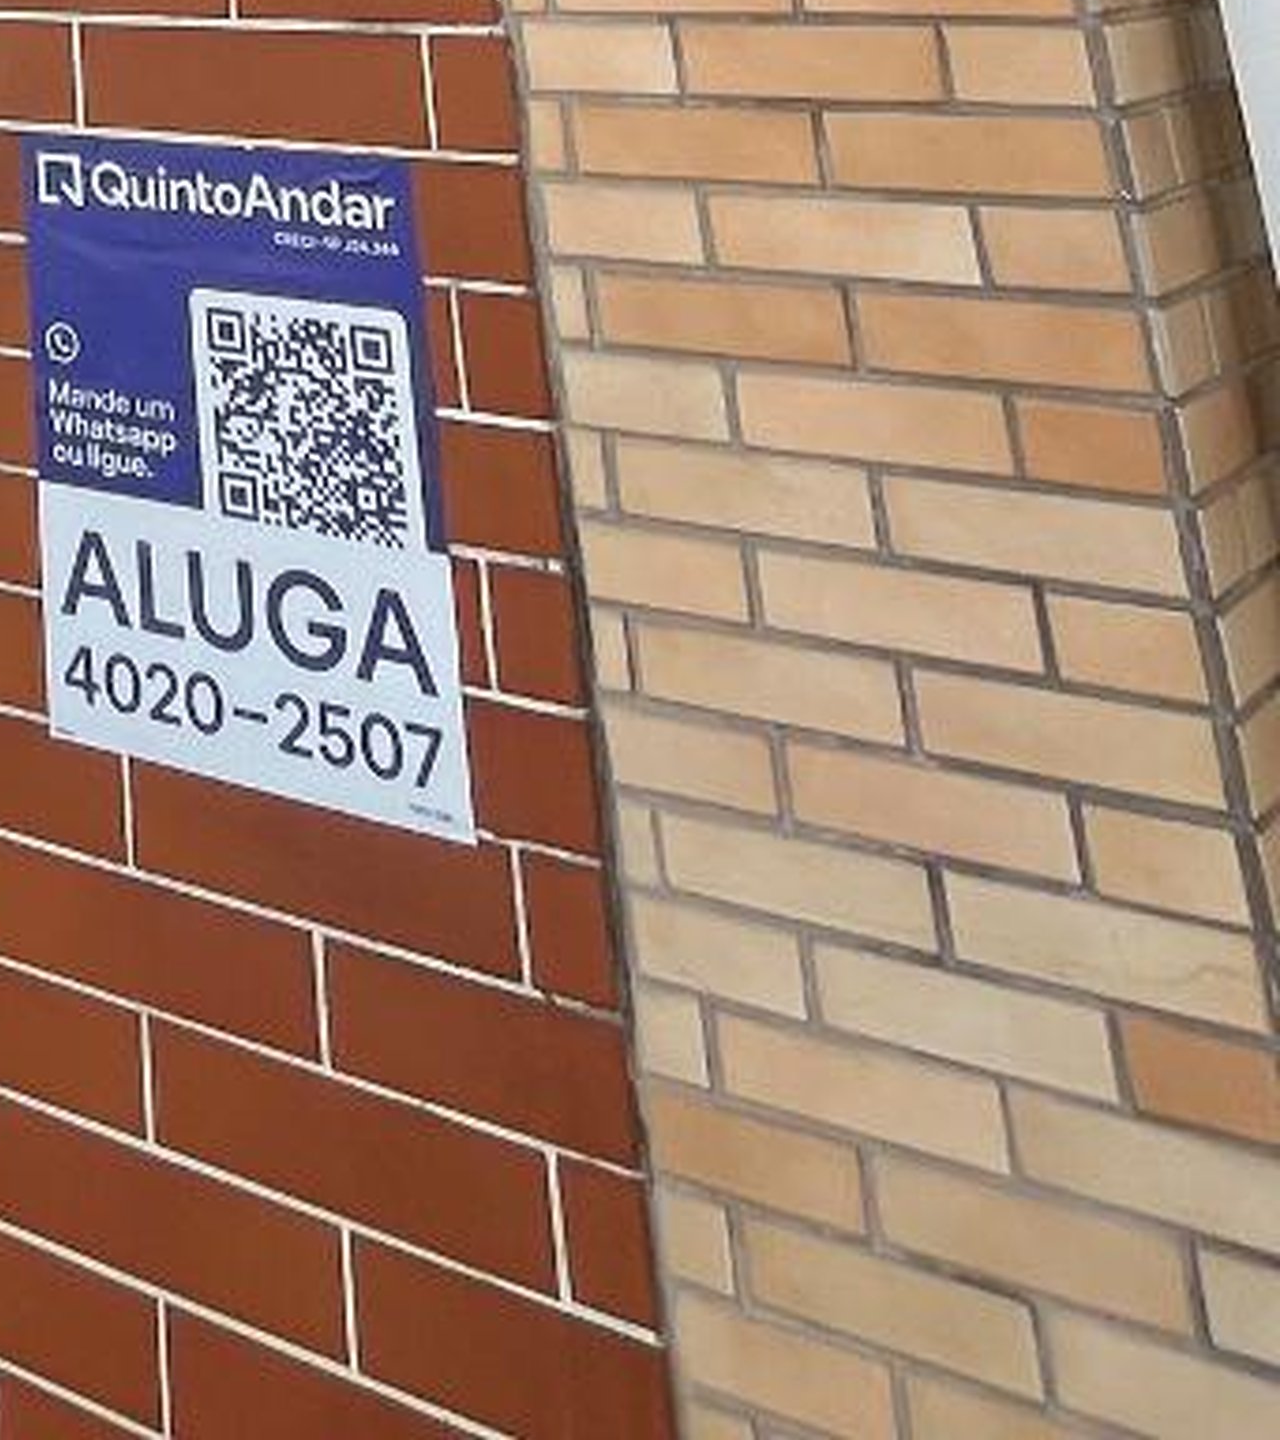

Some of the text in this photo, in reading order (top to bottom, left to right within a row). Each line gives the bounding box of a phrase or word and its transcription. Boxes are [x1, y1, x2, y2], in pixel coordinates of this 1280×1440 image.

[91, 161, 395, 230] QuintoAndar
[48, 377, 176, 422] Mande um
[49, 407, 177, 459] Whatsapp
[53, 441, 156, 478] ou ligue.
[60, 529, 441, 698] ALUGA
[63, 645, 443, 789] 4020-2507
